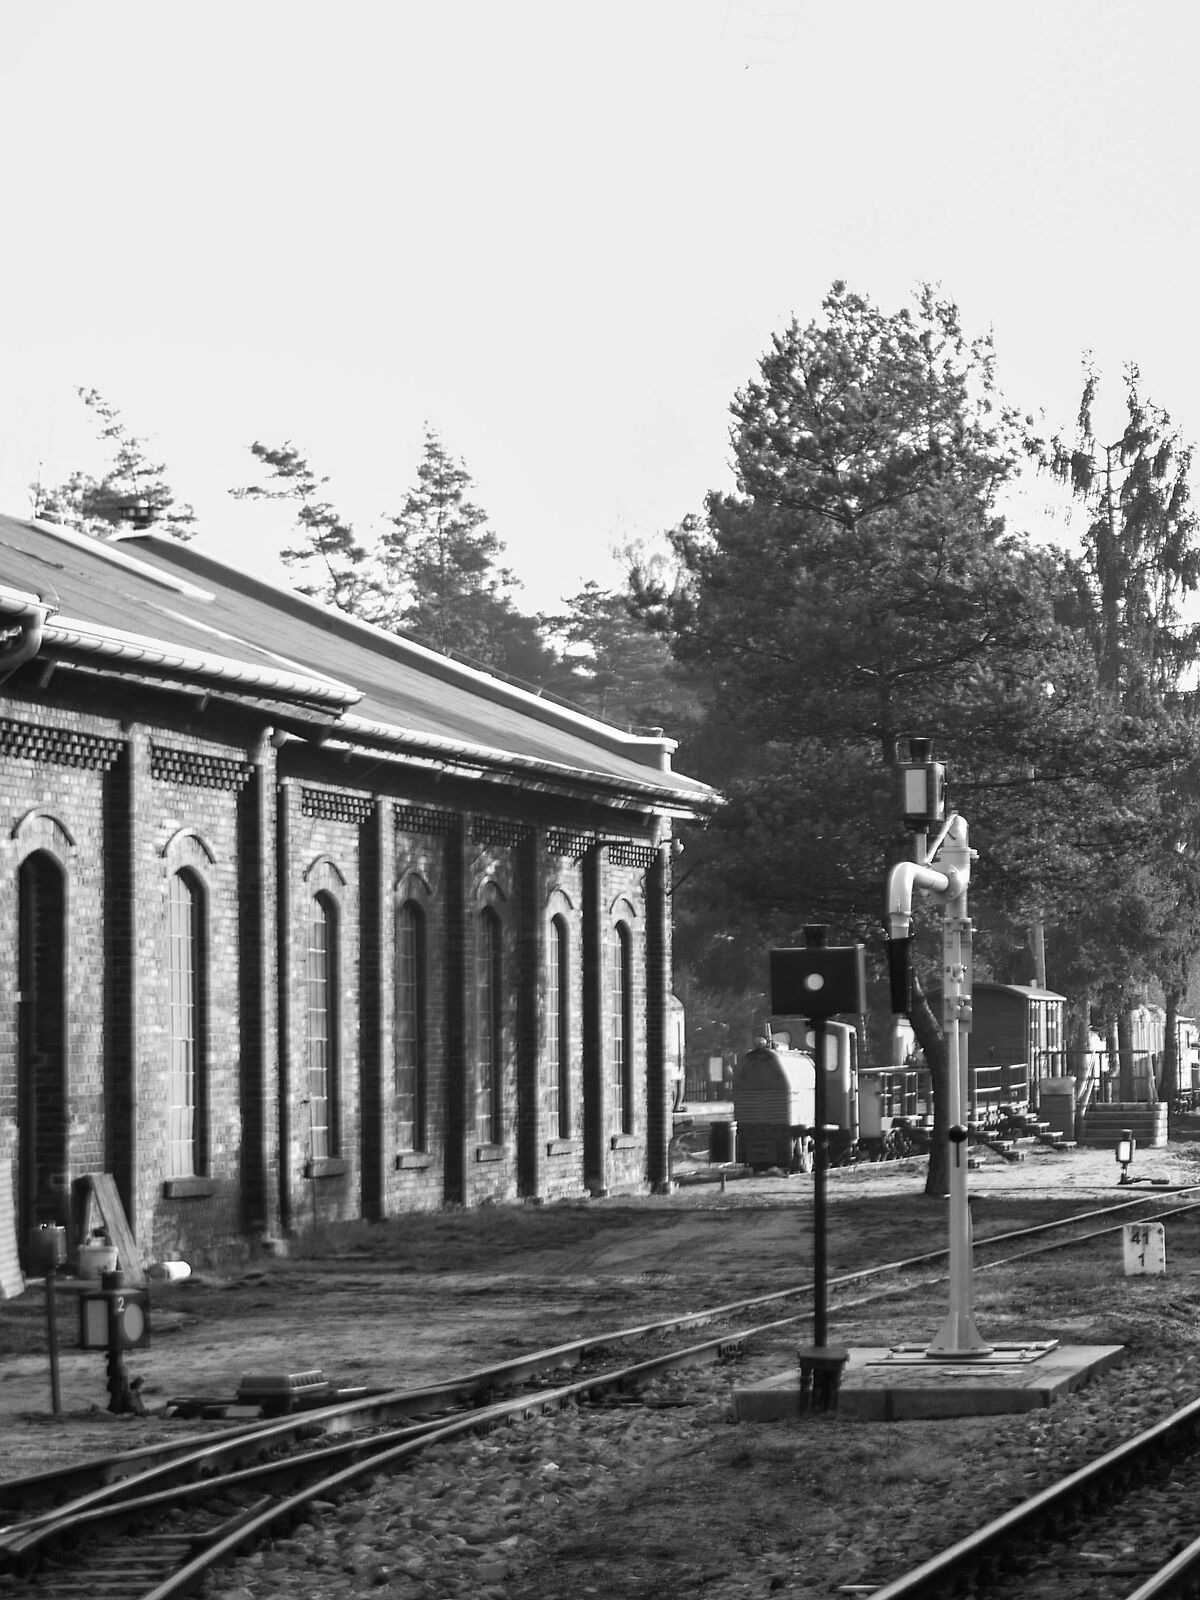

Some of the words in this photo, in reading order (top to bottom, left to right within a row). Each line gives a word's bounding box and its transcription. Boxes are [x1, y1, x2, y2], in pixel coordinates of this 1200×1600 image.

[1131, 1231, 1148, 1245] 41
[1138, 1252, 1145, 1267] 1
[118, 1296, 124, 1312] 2
